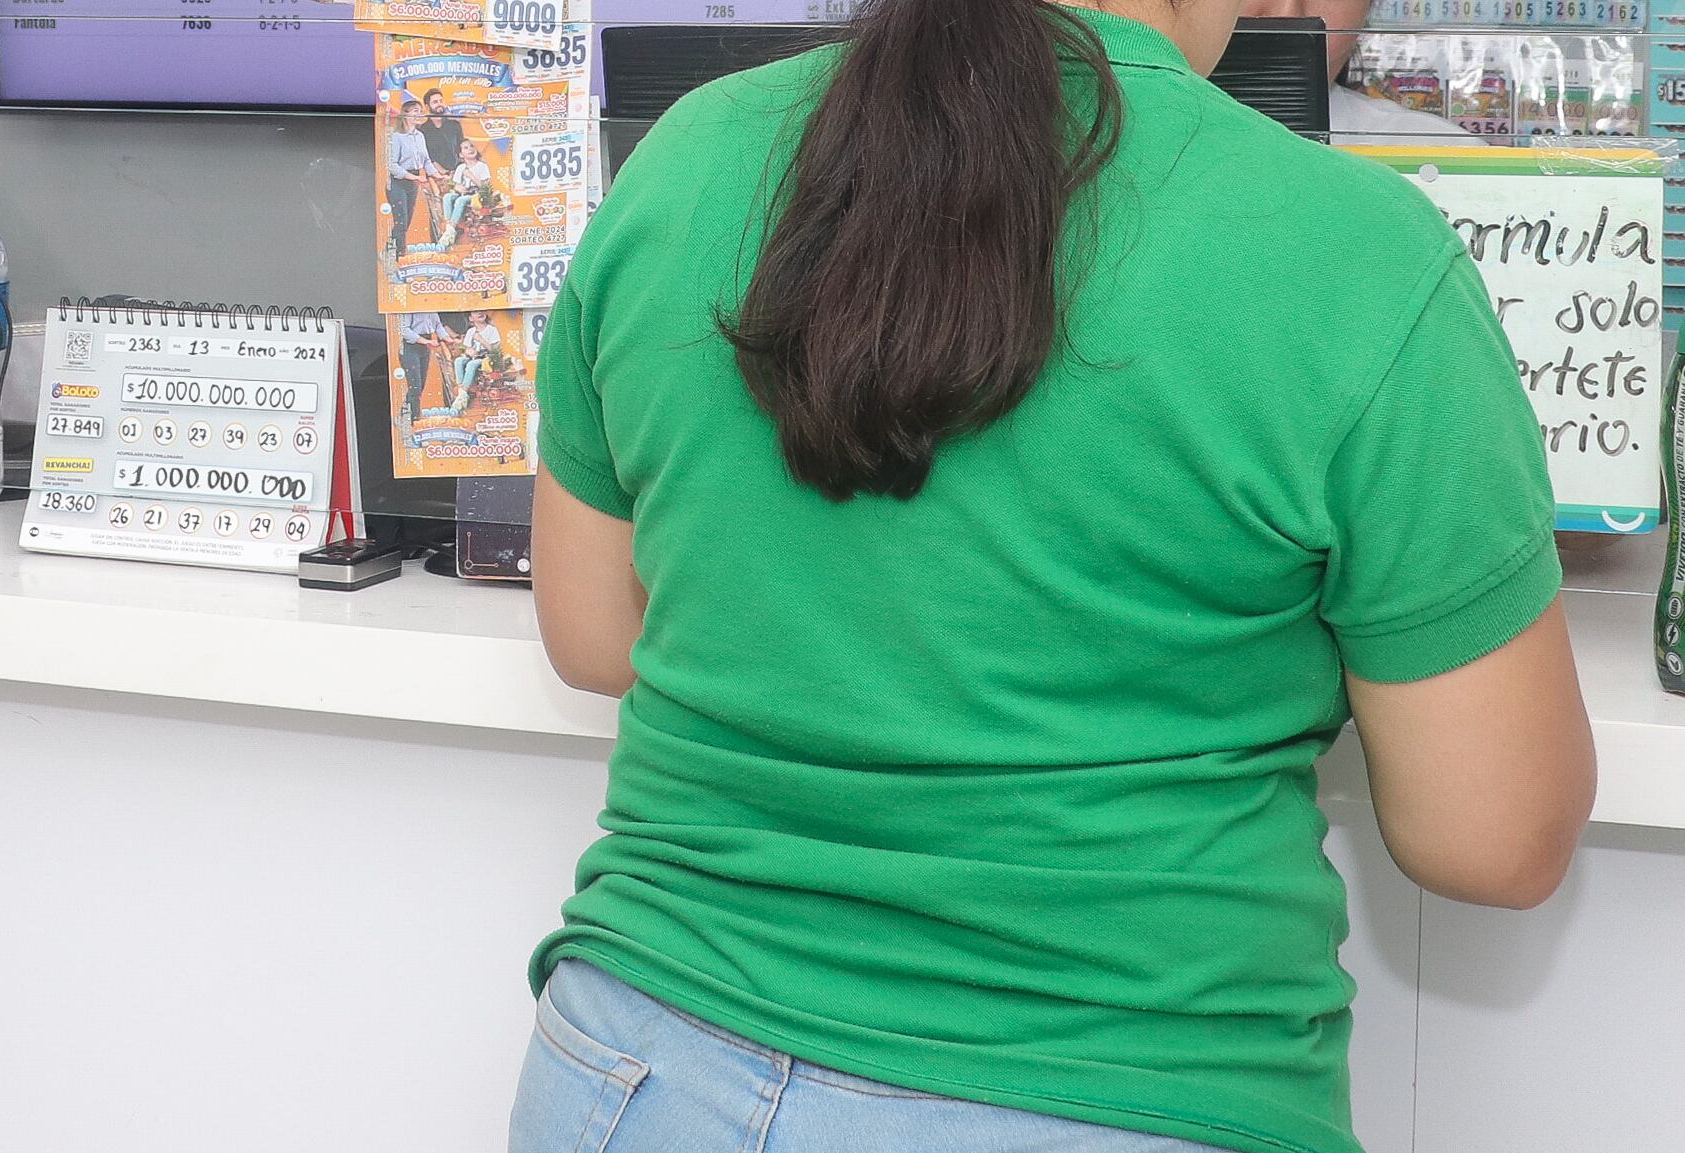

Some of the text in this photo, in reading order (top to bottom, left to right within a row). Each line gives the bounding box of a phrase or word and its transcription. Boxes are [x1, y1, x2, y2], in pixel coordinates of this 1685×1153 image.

[388, 4, 480, 22] $6.000.000.000
[705, 4, 735, 19] 7285
[1391, 1, 1639, 21] 1646 5304 1505 5263 2162
[393, 62, 501, 80] $2.000.000 MENSUALES
[520, 146, 582, 181] 3835
[518, 260, 567, 293] 383
[411, 280, 504, 293] $6.000.000.000
[1555, 280, 1660, 334] solo
[128, 337, 325, 361] 2363 13 Enero 2024
[62, 385, 99, 398] Baloto
[51, 418, 101, 435] 27.849
[122, 424, 313, 447] 01 03 27 39 23 07
[427, 446, 521, 457] $6.000.000.000
[45, 460, 91, 470] REVANCHA!
[41, 491, 95, 513] 18.360
[110, 508, 129, 523] 26
[144, 510, 163, 524] 21
[180, 512, 200, 530] 37
[218, 516, 232, 531] 17
[250, 517, 271, 532] 29
